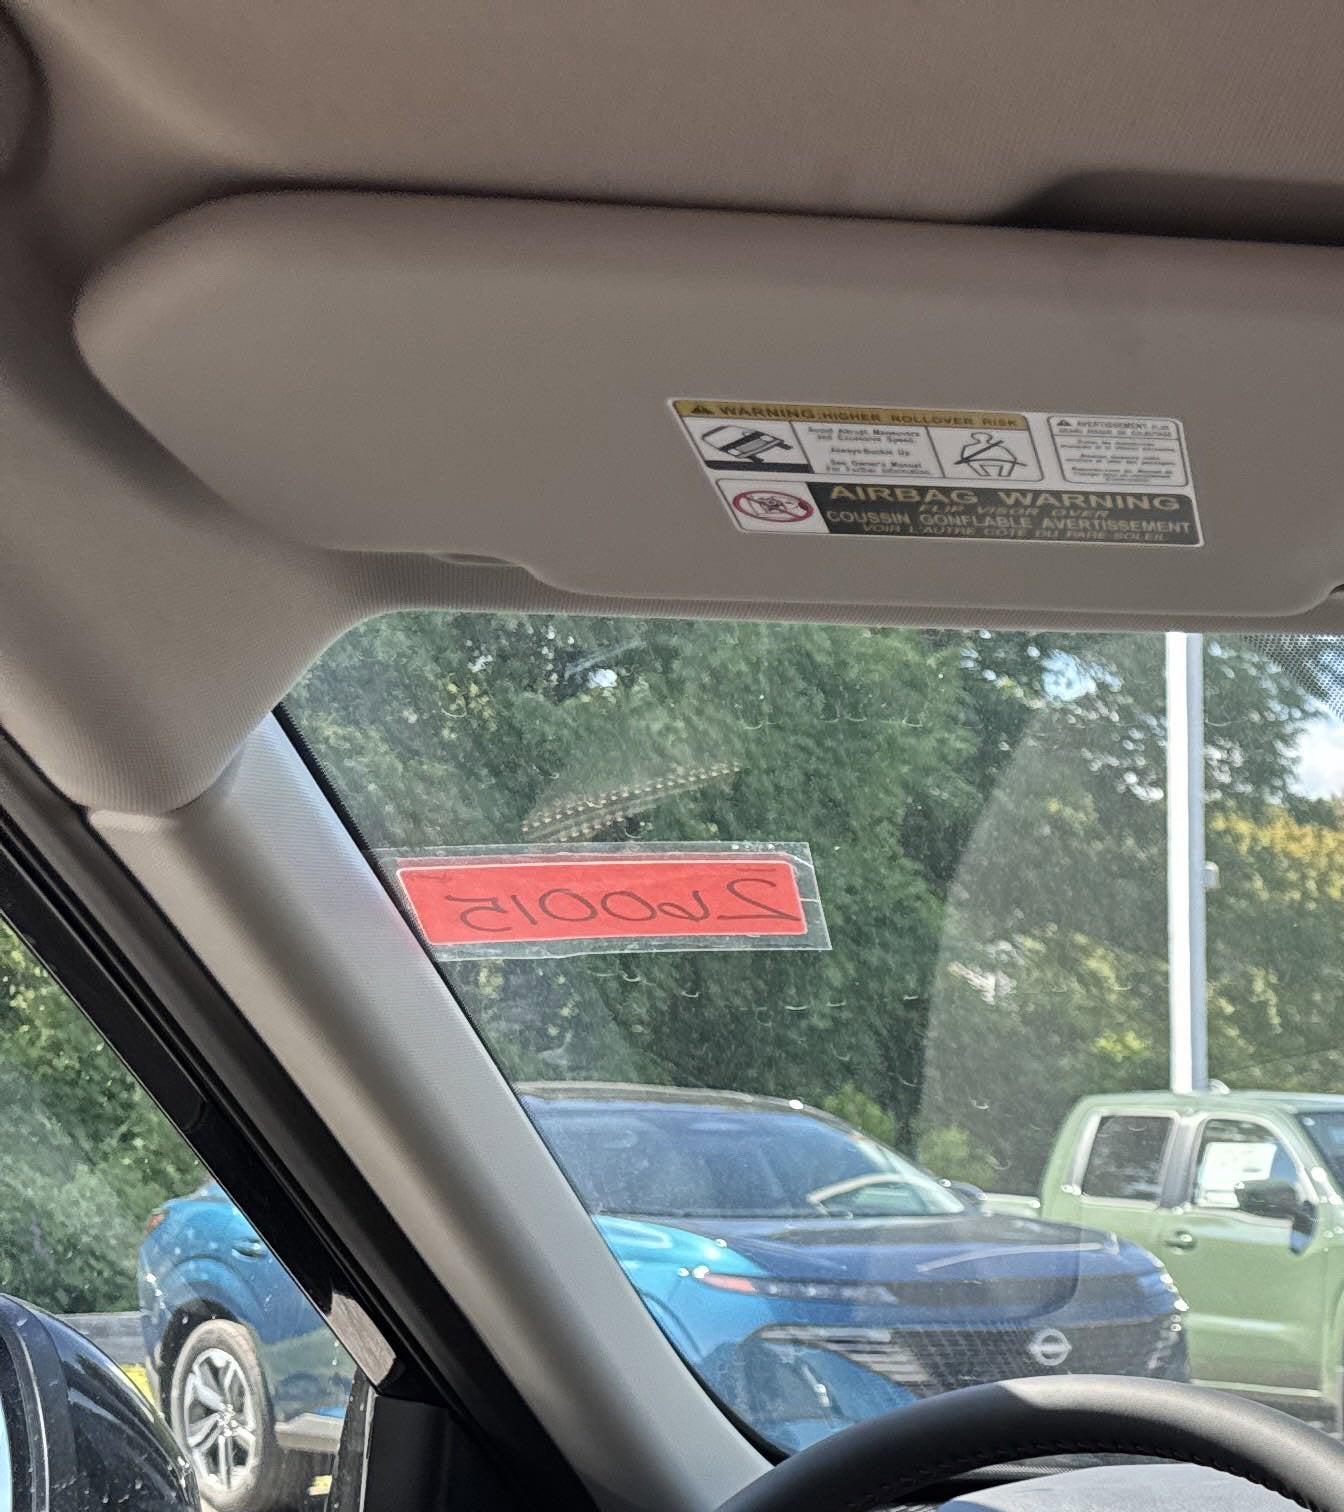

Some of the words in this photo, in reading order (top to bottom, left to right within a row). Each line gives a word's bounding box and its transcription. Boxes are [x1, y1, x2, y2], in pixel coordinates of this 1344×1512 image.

[823, 409, 881, 421] HIGHER
[891, 412, 974, 426] ROLLOVER
[983, 417, 1018, 427] RISK
[830, 485, 978, 505] AIRBAG
[997, 490, 1181, 511] WARNING
[977, 506, 1042, 517] VISOR
[1050, 508, 1109, 518] OVER
[826, 511, 911, 526] COUSSIN
[918, 513, 1033, 530] GONFLABLE
[1042, 517, 1191, 534] AVERTISSEMENT
